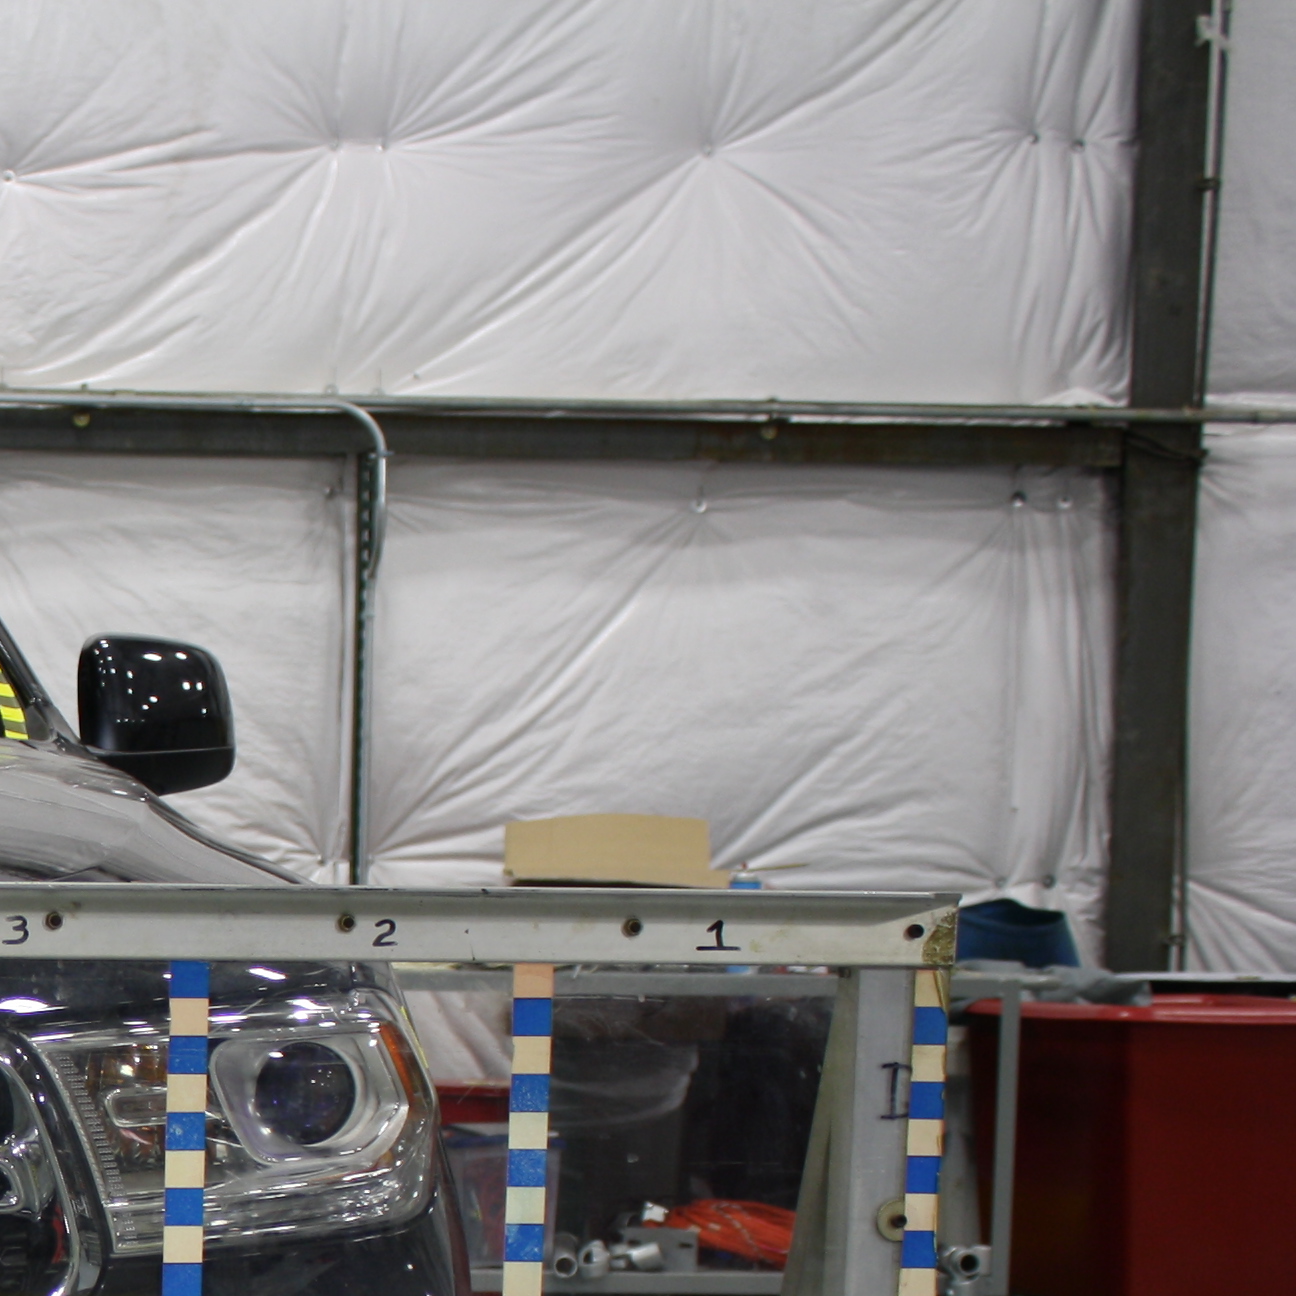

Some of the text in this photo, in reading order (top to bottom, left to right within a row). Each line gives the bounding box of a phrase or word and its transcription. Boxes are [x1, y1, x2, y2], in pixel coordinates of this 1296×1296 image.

[1, 914, 30, 945] 3
[372, 917, 399, 947] 2
[695, 918, 742, 952] 1
